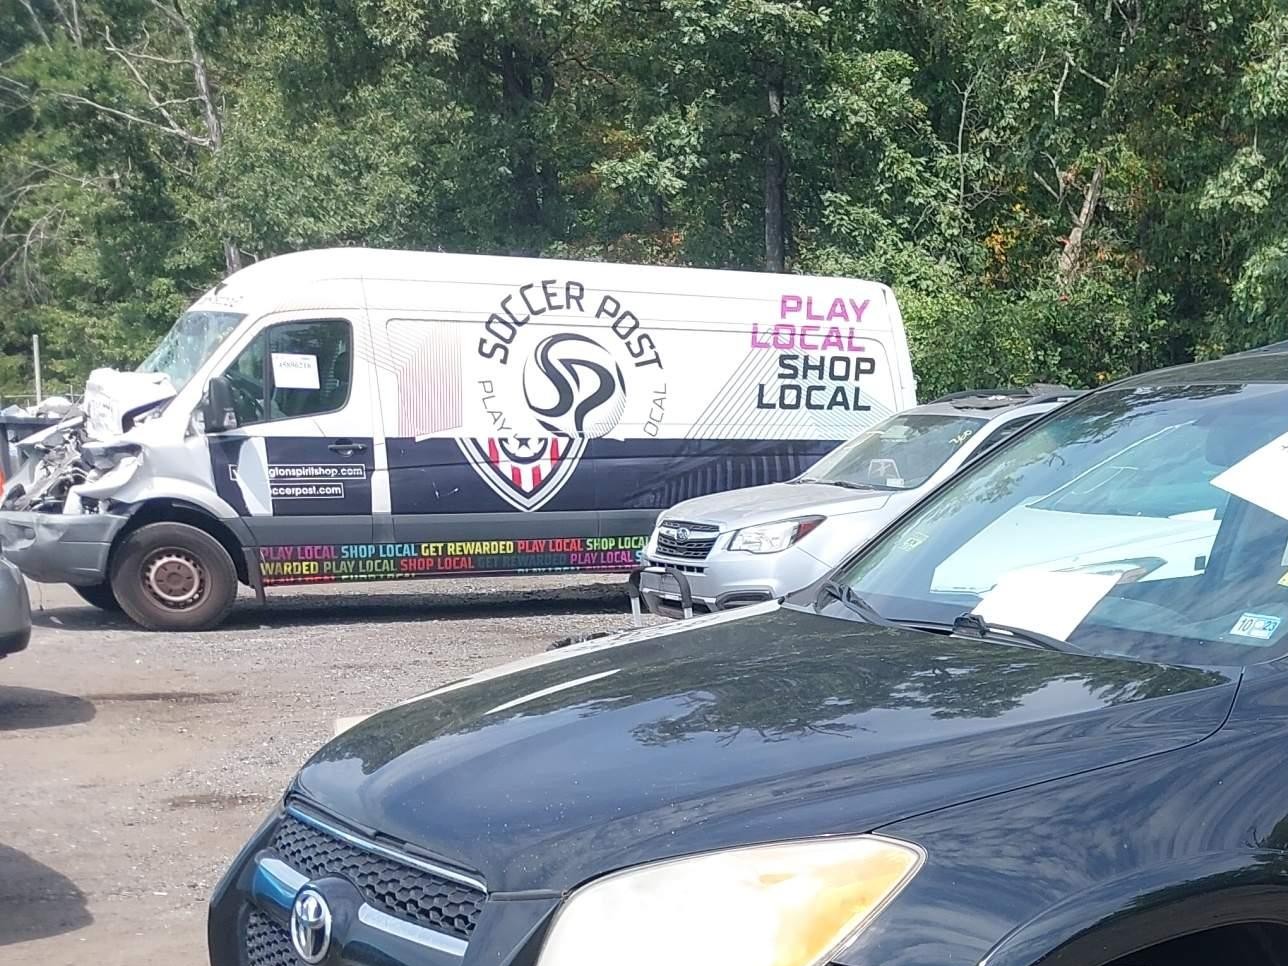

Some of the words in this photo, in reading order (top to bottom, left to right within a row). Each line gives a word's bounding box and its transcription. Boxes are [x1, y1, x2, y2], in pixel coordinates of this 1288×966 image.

[781, 295, 870, 322] PLAY
[478, 280, 584, 365] SOCCER
[595, 295, 664, 370] POST
[751, 323, 866, 352] LOCAL
[778, 355, 876, 381] SHOP
[478, 380, 512, 431] PLAY
[643, 383, 667, 437] OCAL
[757, 384, 872, 411] LOCAL
[233, 466, 363, 478] gtonspiritshop.com
[271, 486, 342, 496] ccerpost.com
[261, 547, 293, 560] PLAY
[299, 546, 338, 560] LOCAL
[341, 545, 375, 558] SHOP
[380, 544, 418, 557] LOCAL
[421, 542, 444, 556] GET
[447, 541, 514, 555] REWARDED
[518, 540, 545, 553] PLAY
[549, 539, 583, 552] LOCAL
[586, 538, 615, 550] SHOP
[324, 560, 355, 574] PLAY
[359, 559, 397, 572] LOCAL
[400, 558, 434, 571] SHOP
[438, 557, 474, 570] LOCAL
[570, 553, 597, 565] PLAY
[601, 551, 633, 564] LOCAL
